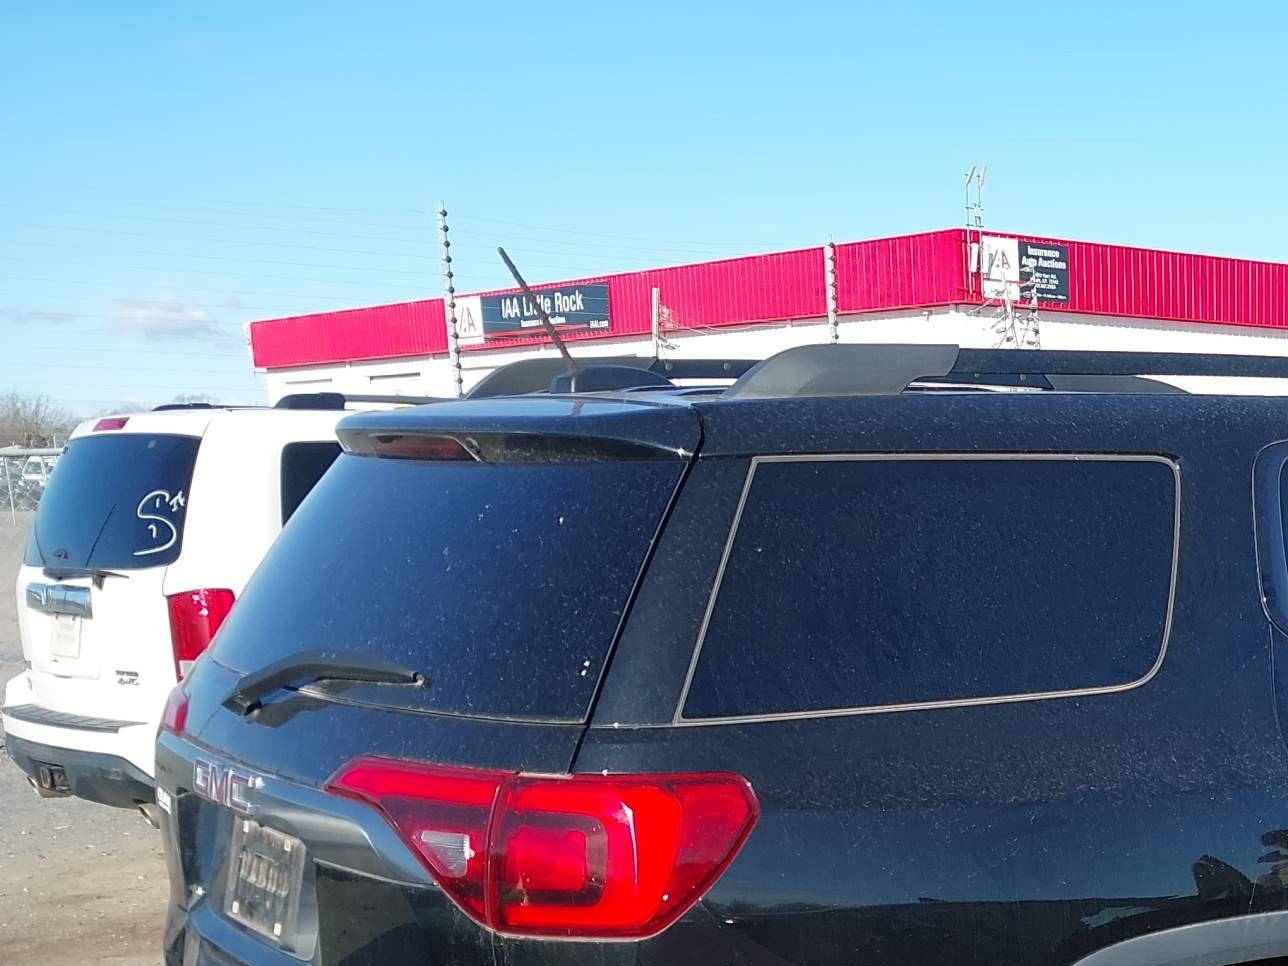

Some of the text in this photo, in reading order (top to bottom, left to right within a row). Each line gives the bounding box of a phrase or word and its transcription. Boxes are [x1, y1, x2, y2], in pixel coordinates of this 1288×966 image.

[1021, 255, 1066, 269] Auto Auctions
[1027, 245, 1060, 258] Insurance
[501, 297, 520, 319] IAA
[554, 290, 584, 313] Rock
[193, 757, 257, 814] GMC
